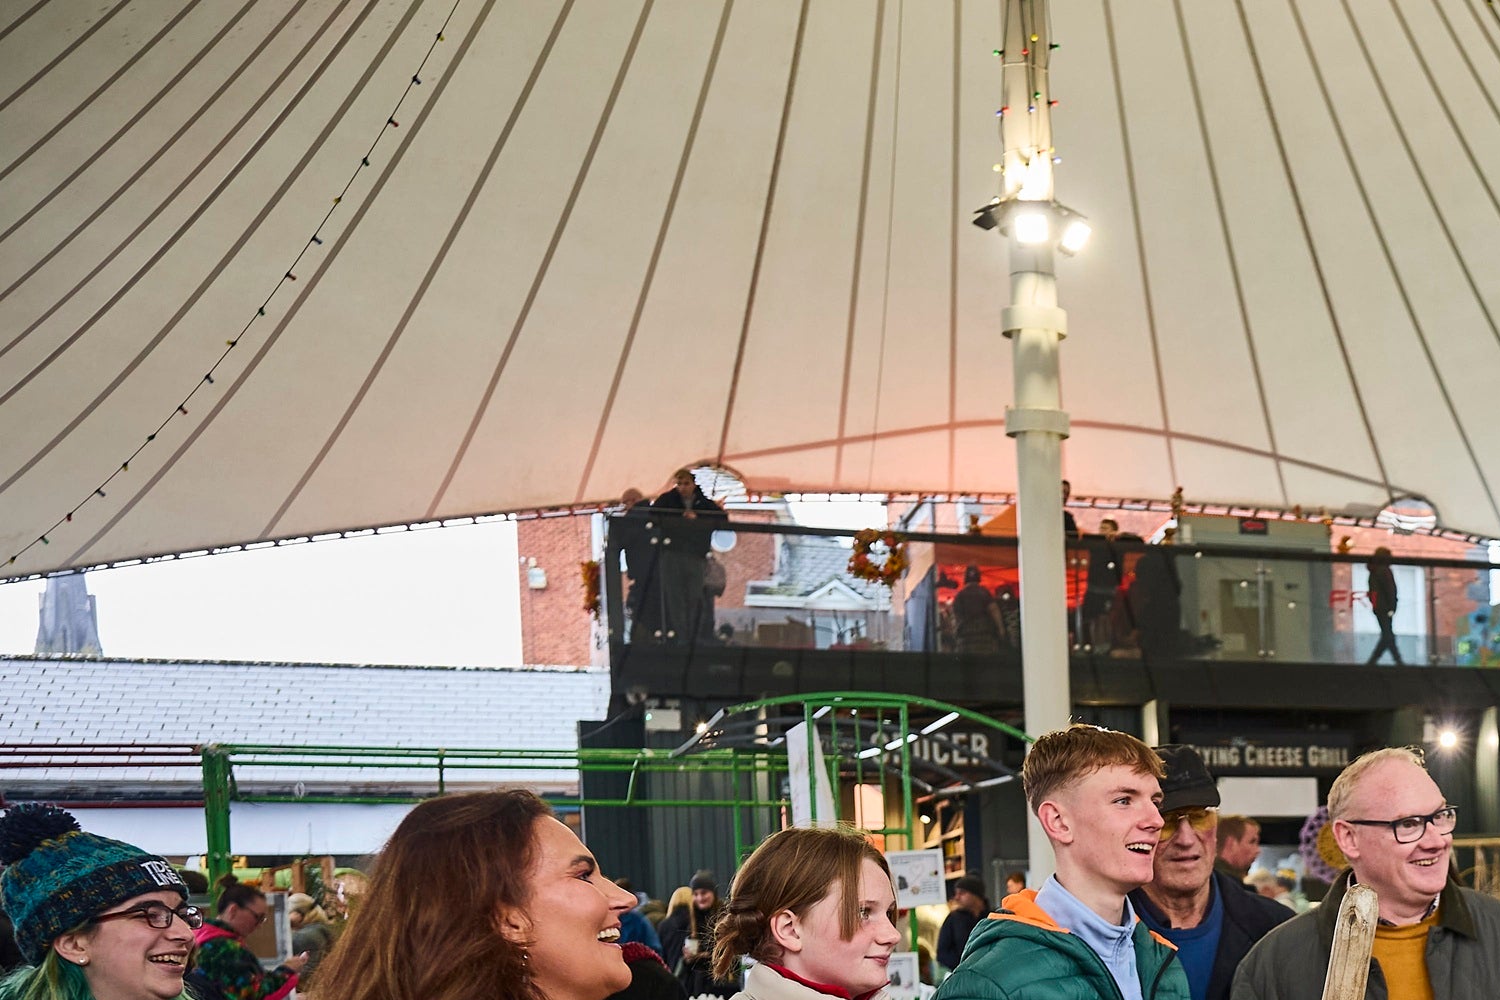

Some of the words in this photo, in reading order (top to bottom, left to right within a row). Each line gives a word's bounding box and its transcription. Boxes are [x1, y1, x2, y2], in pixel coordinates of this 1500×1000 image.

[871, 732, 989, 766] SUCER
[1199, 746, 1240, 766] YING
[1245, 745, 1304, 767] CHEESE
[1308, 745, 1348, 767] GRILL
[140, 860, 172, 874] TIDE
